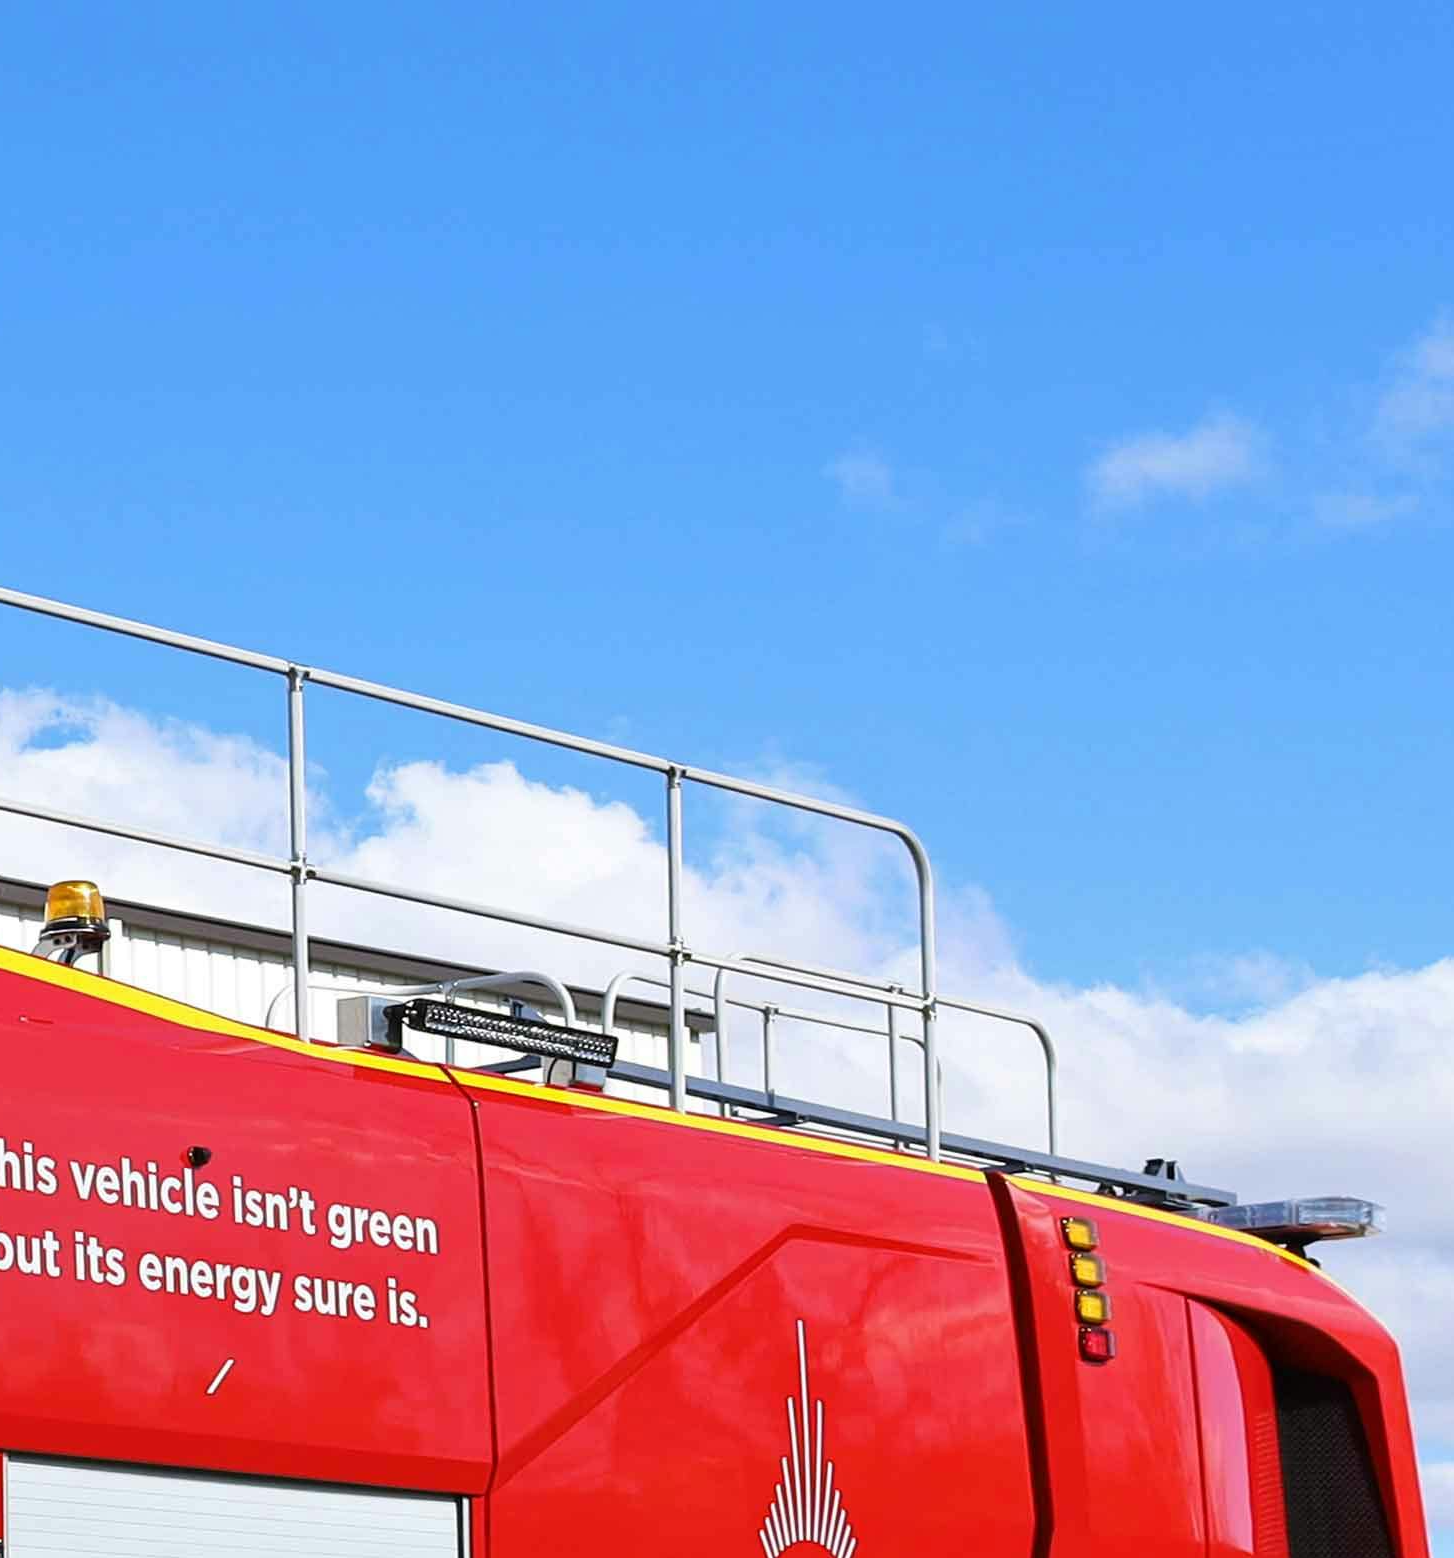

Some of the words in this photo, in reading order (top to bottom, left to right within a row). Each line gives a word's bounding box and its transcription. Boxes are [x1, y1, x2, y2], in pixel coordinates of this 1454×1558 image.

[69, 1156, 220, 1220] vehicle
[232, 1175, 316, 1235] isn’t
[327, 1203, 438, 1255] green
[74, 1230, 126, 1286] its
[138, 1253, 281, 1316] energy
[294, 1275, 376, 1321] sure
[387, 1277, 429, 1329] is.
